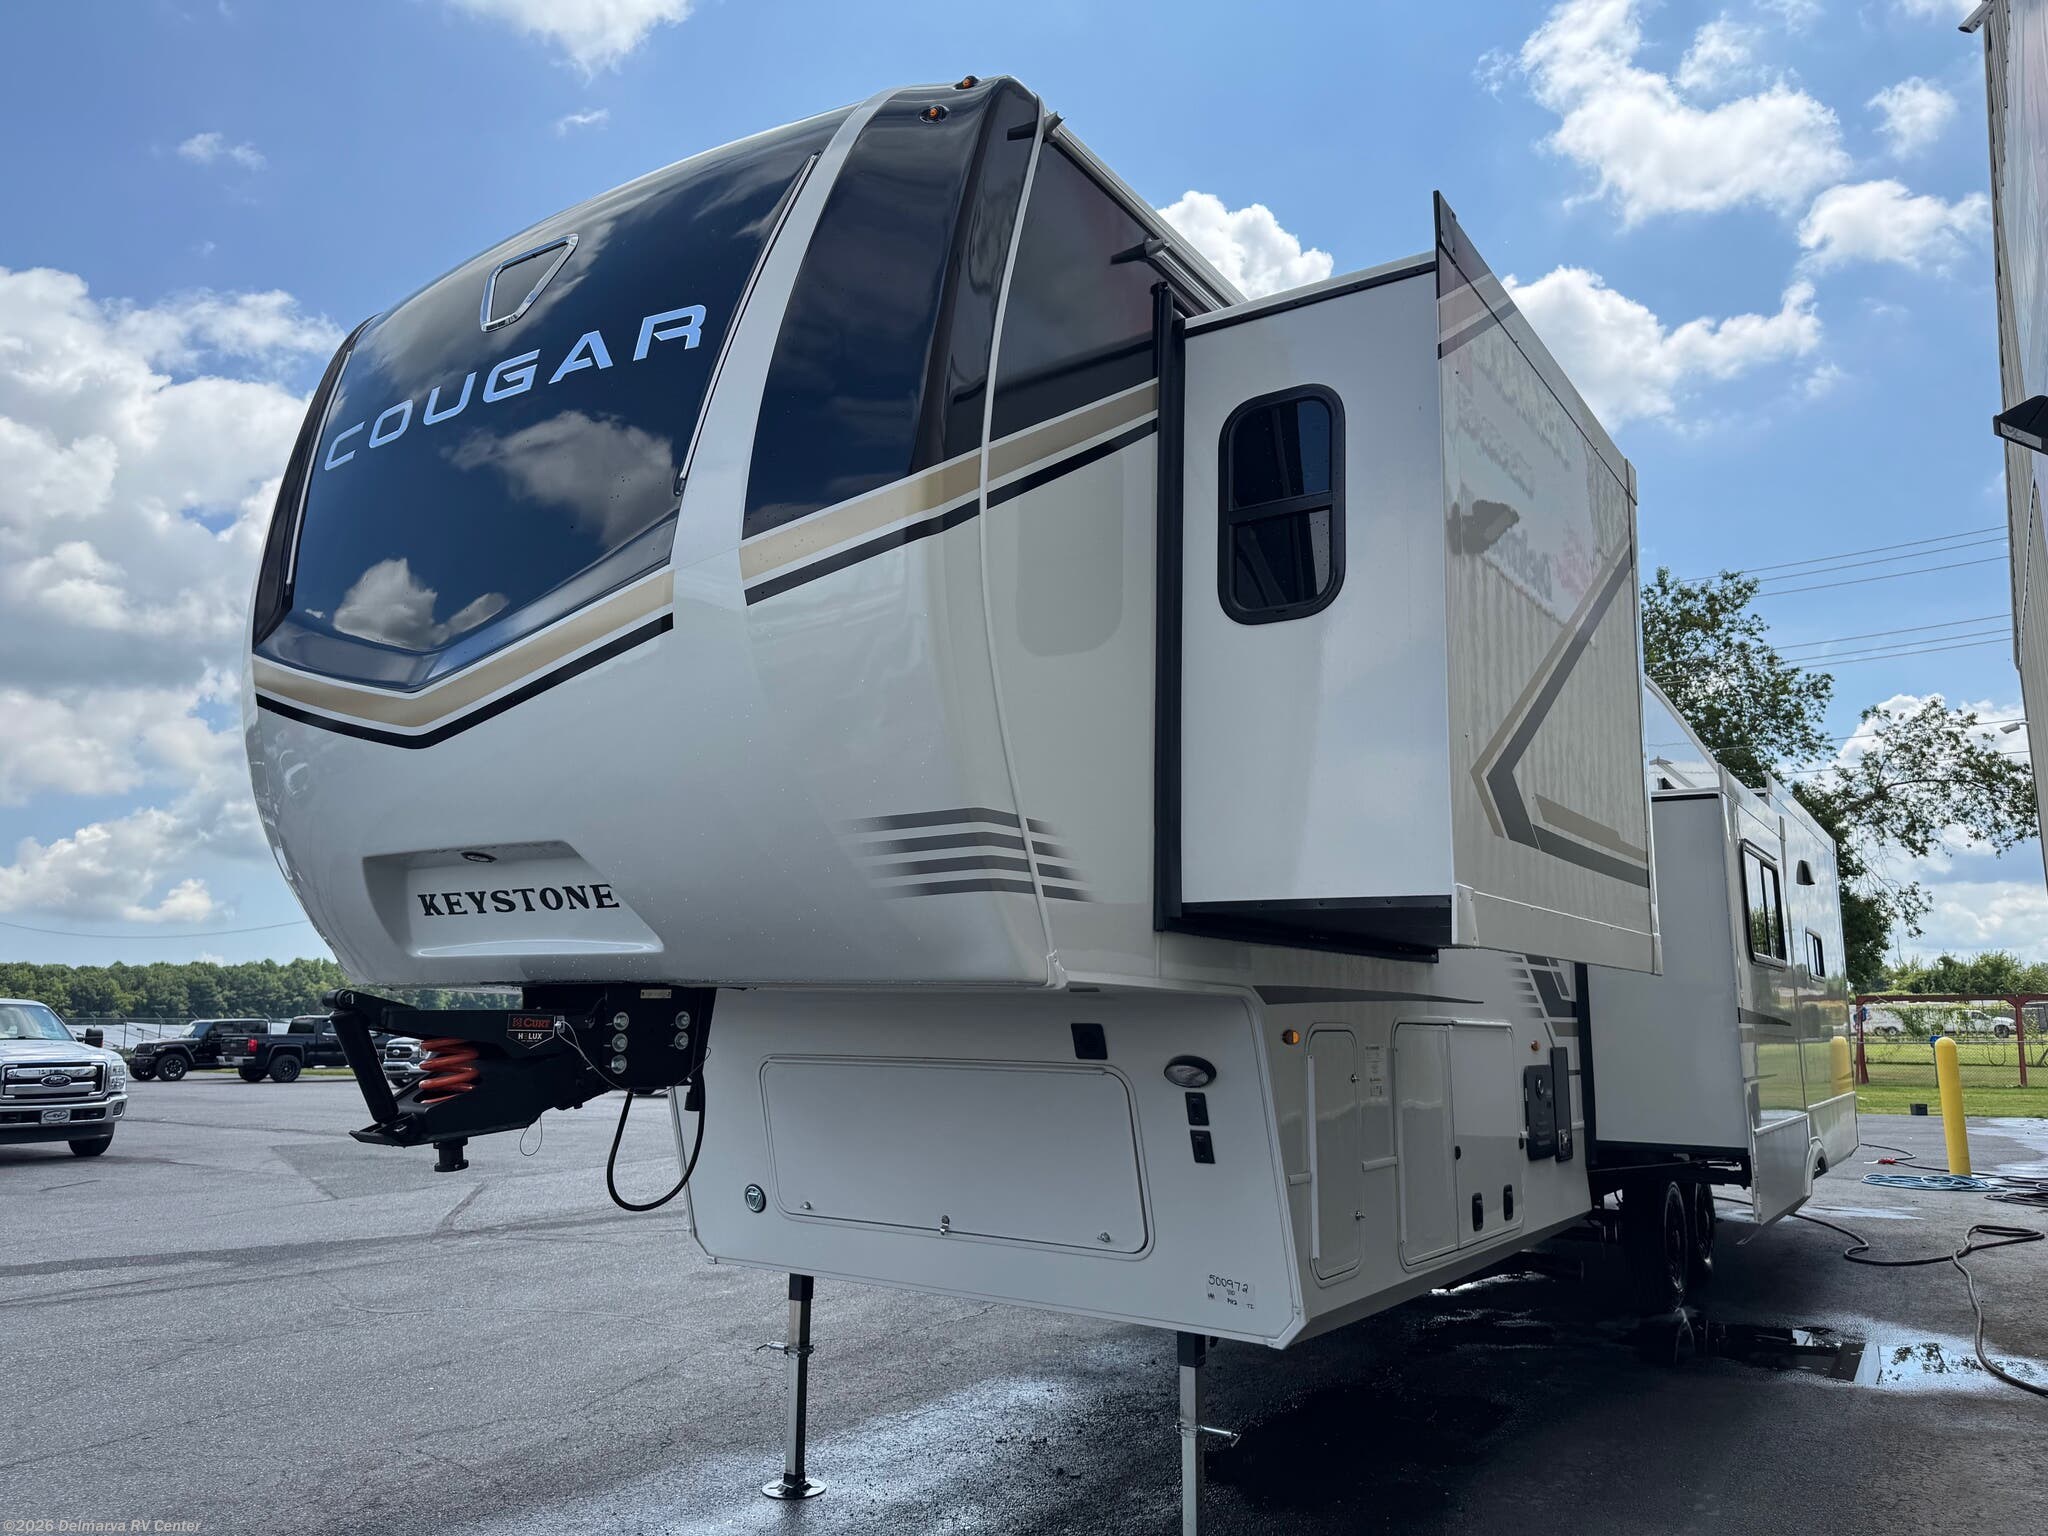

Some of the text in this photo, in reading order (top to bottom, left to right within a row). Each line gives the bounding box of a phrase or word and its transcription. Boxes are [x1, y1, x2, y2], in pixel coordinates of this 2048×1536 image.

[325, 304, 707, 471] COUGAR
[417, 884, 620, 916] KEYSTONE
[1208, 1274, 1249, 1294] 500972
